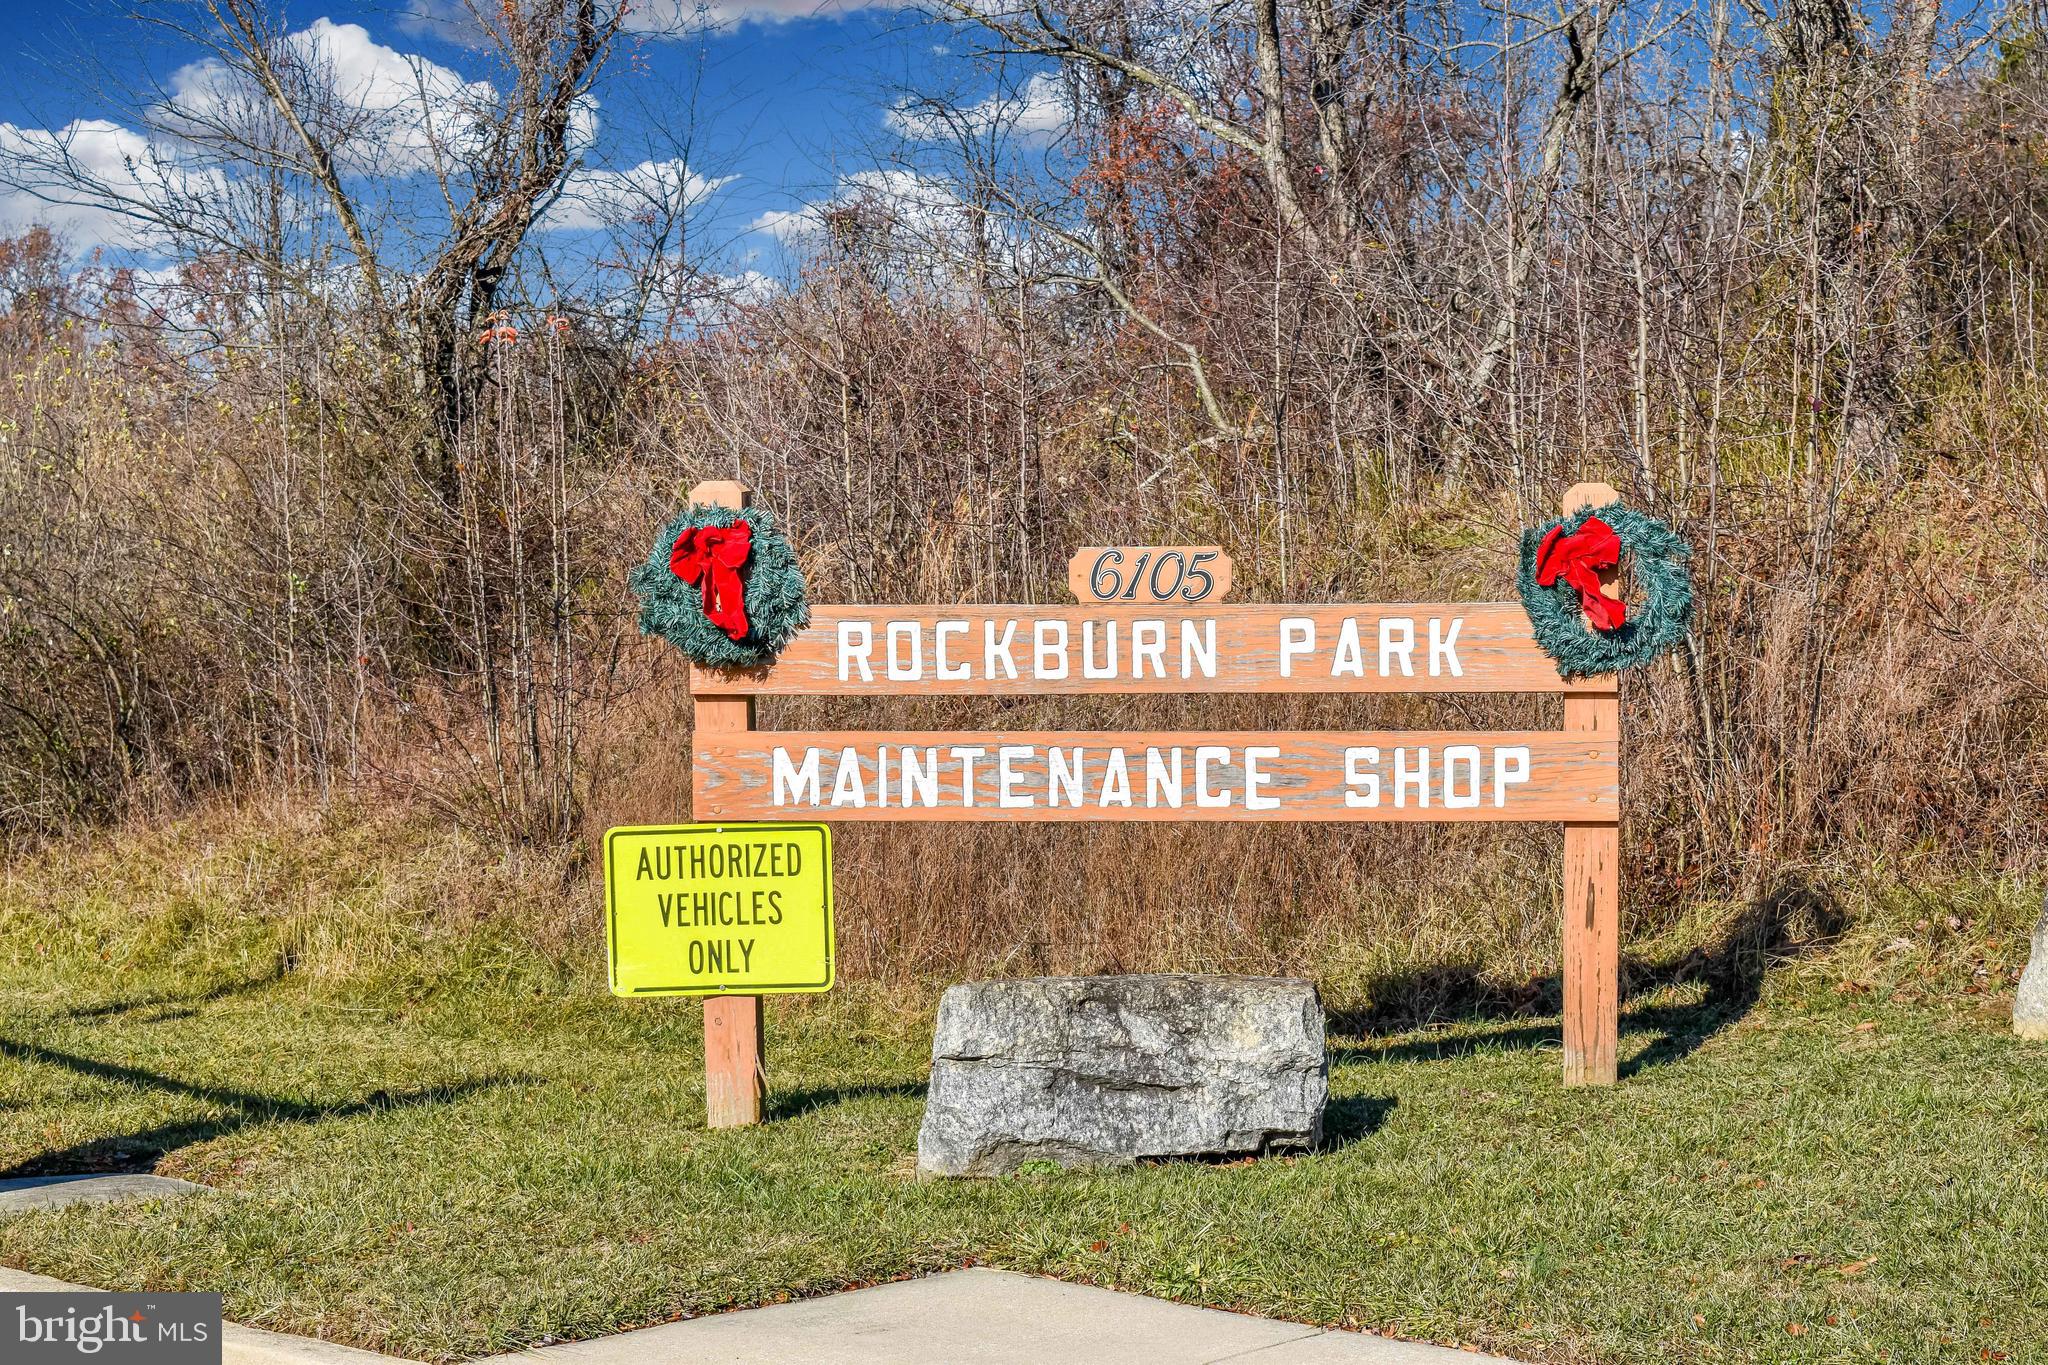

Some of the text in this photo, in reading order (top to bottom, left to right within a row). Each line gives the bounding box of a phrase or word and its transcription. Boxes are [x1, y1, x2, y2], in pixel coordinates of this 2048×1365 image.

[1090, 549, 1219, 602] 6105
[836, 617, 1466, 683] ROCKBURN PARK
[772, 745, 1532, 811] MAINTENANCE SHOP
[636, 843, 801, 881] AUTHORIZED
[657, 890, 783, 928] VEHICLES
[688, 939, 756, 975] ONLY
